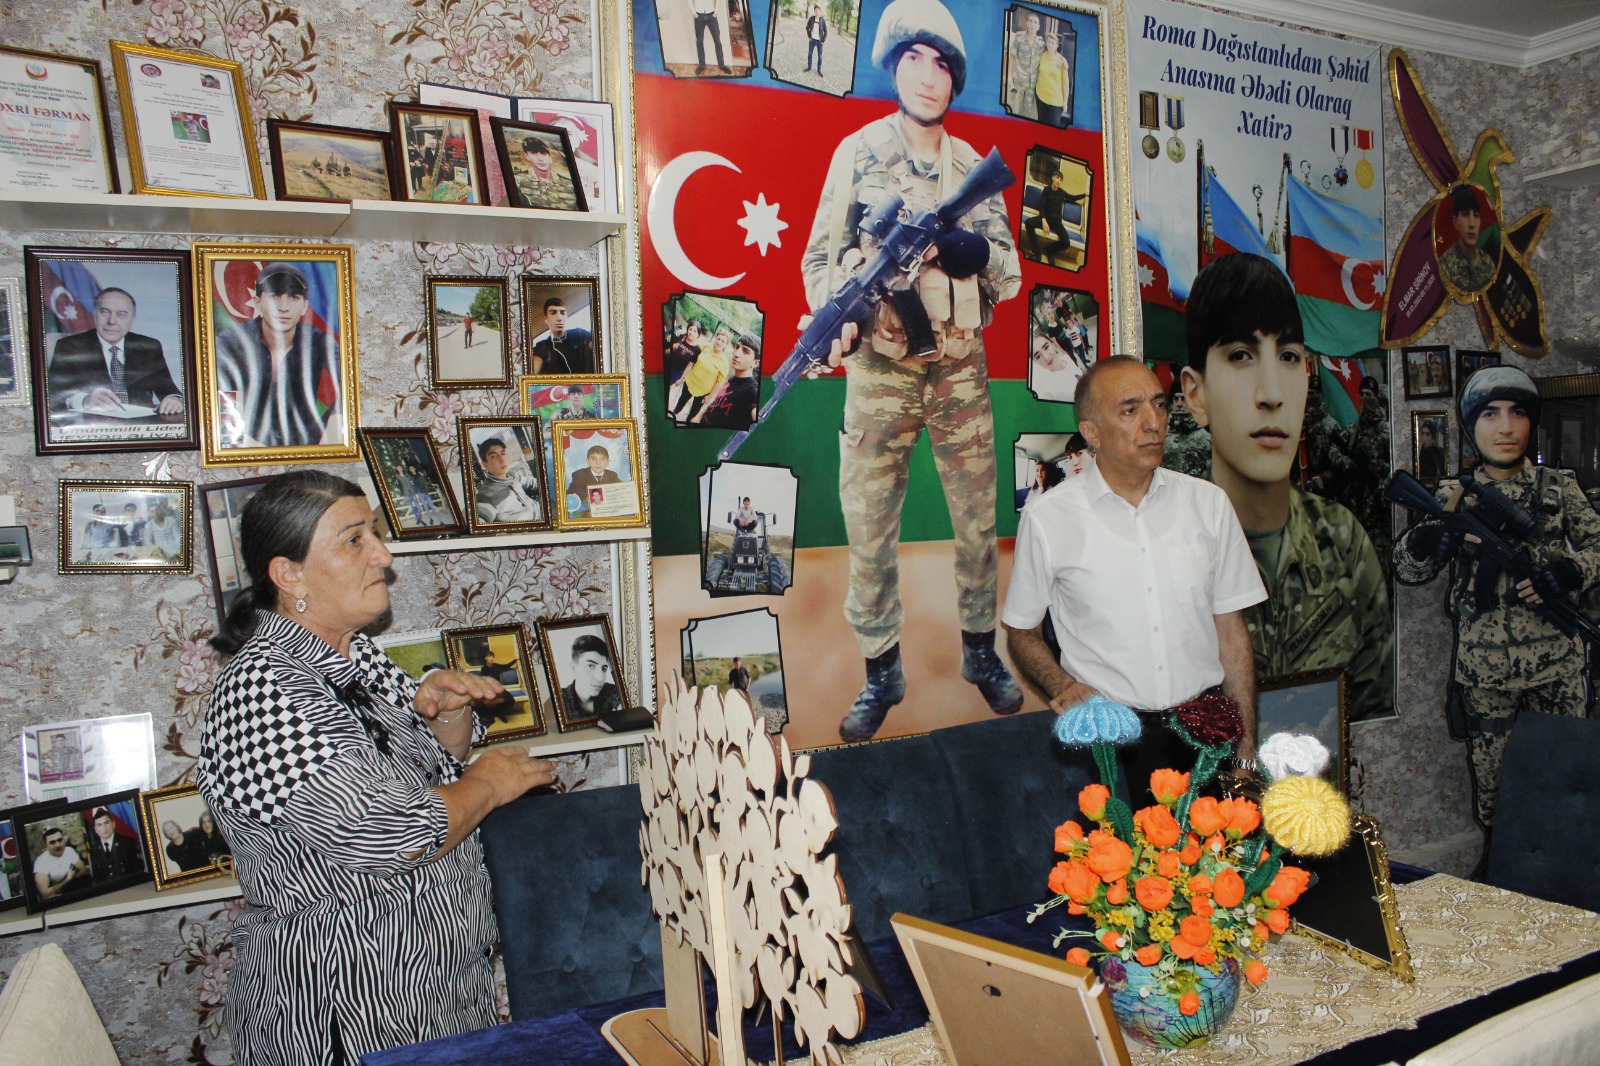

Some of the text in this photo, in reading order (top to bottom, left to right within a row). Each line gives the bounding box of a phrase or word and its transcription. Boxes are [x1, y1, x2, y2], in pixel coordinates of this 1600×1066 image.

[1142, 15, 1370, 84] Roma Dağıstanlıdan Şəhid
[1160, 58, 1353, 121] Anasına Əbədi Olaraq
[33, 107, 91, 122] FƏRMAN
[1237, 110, 1293, 141] Xatirə
[1398, 287, 1415, 311] ELMAR
